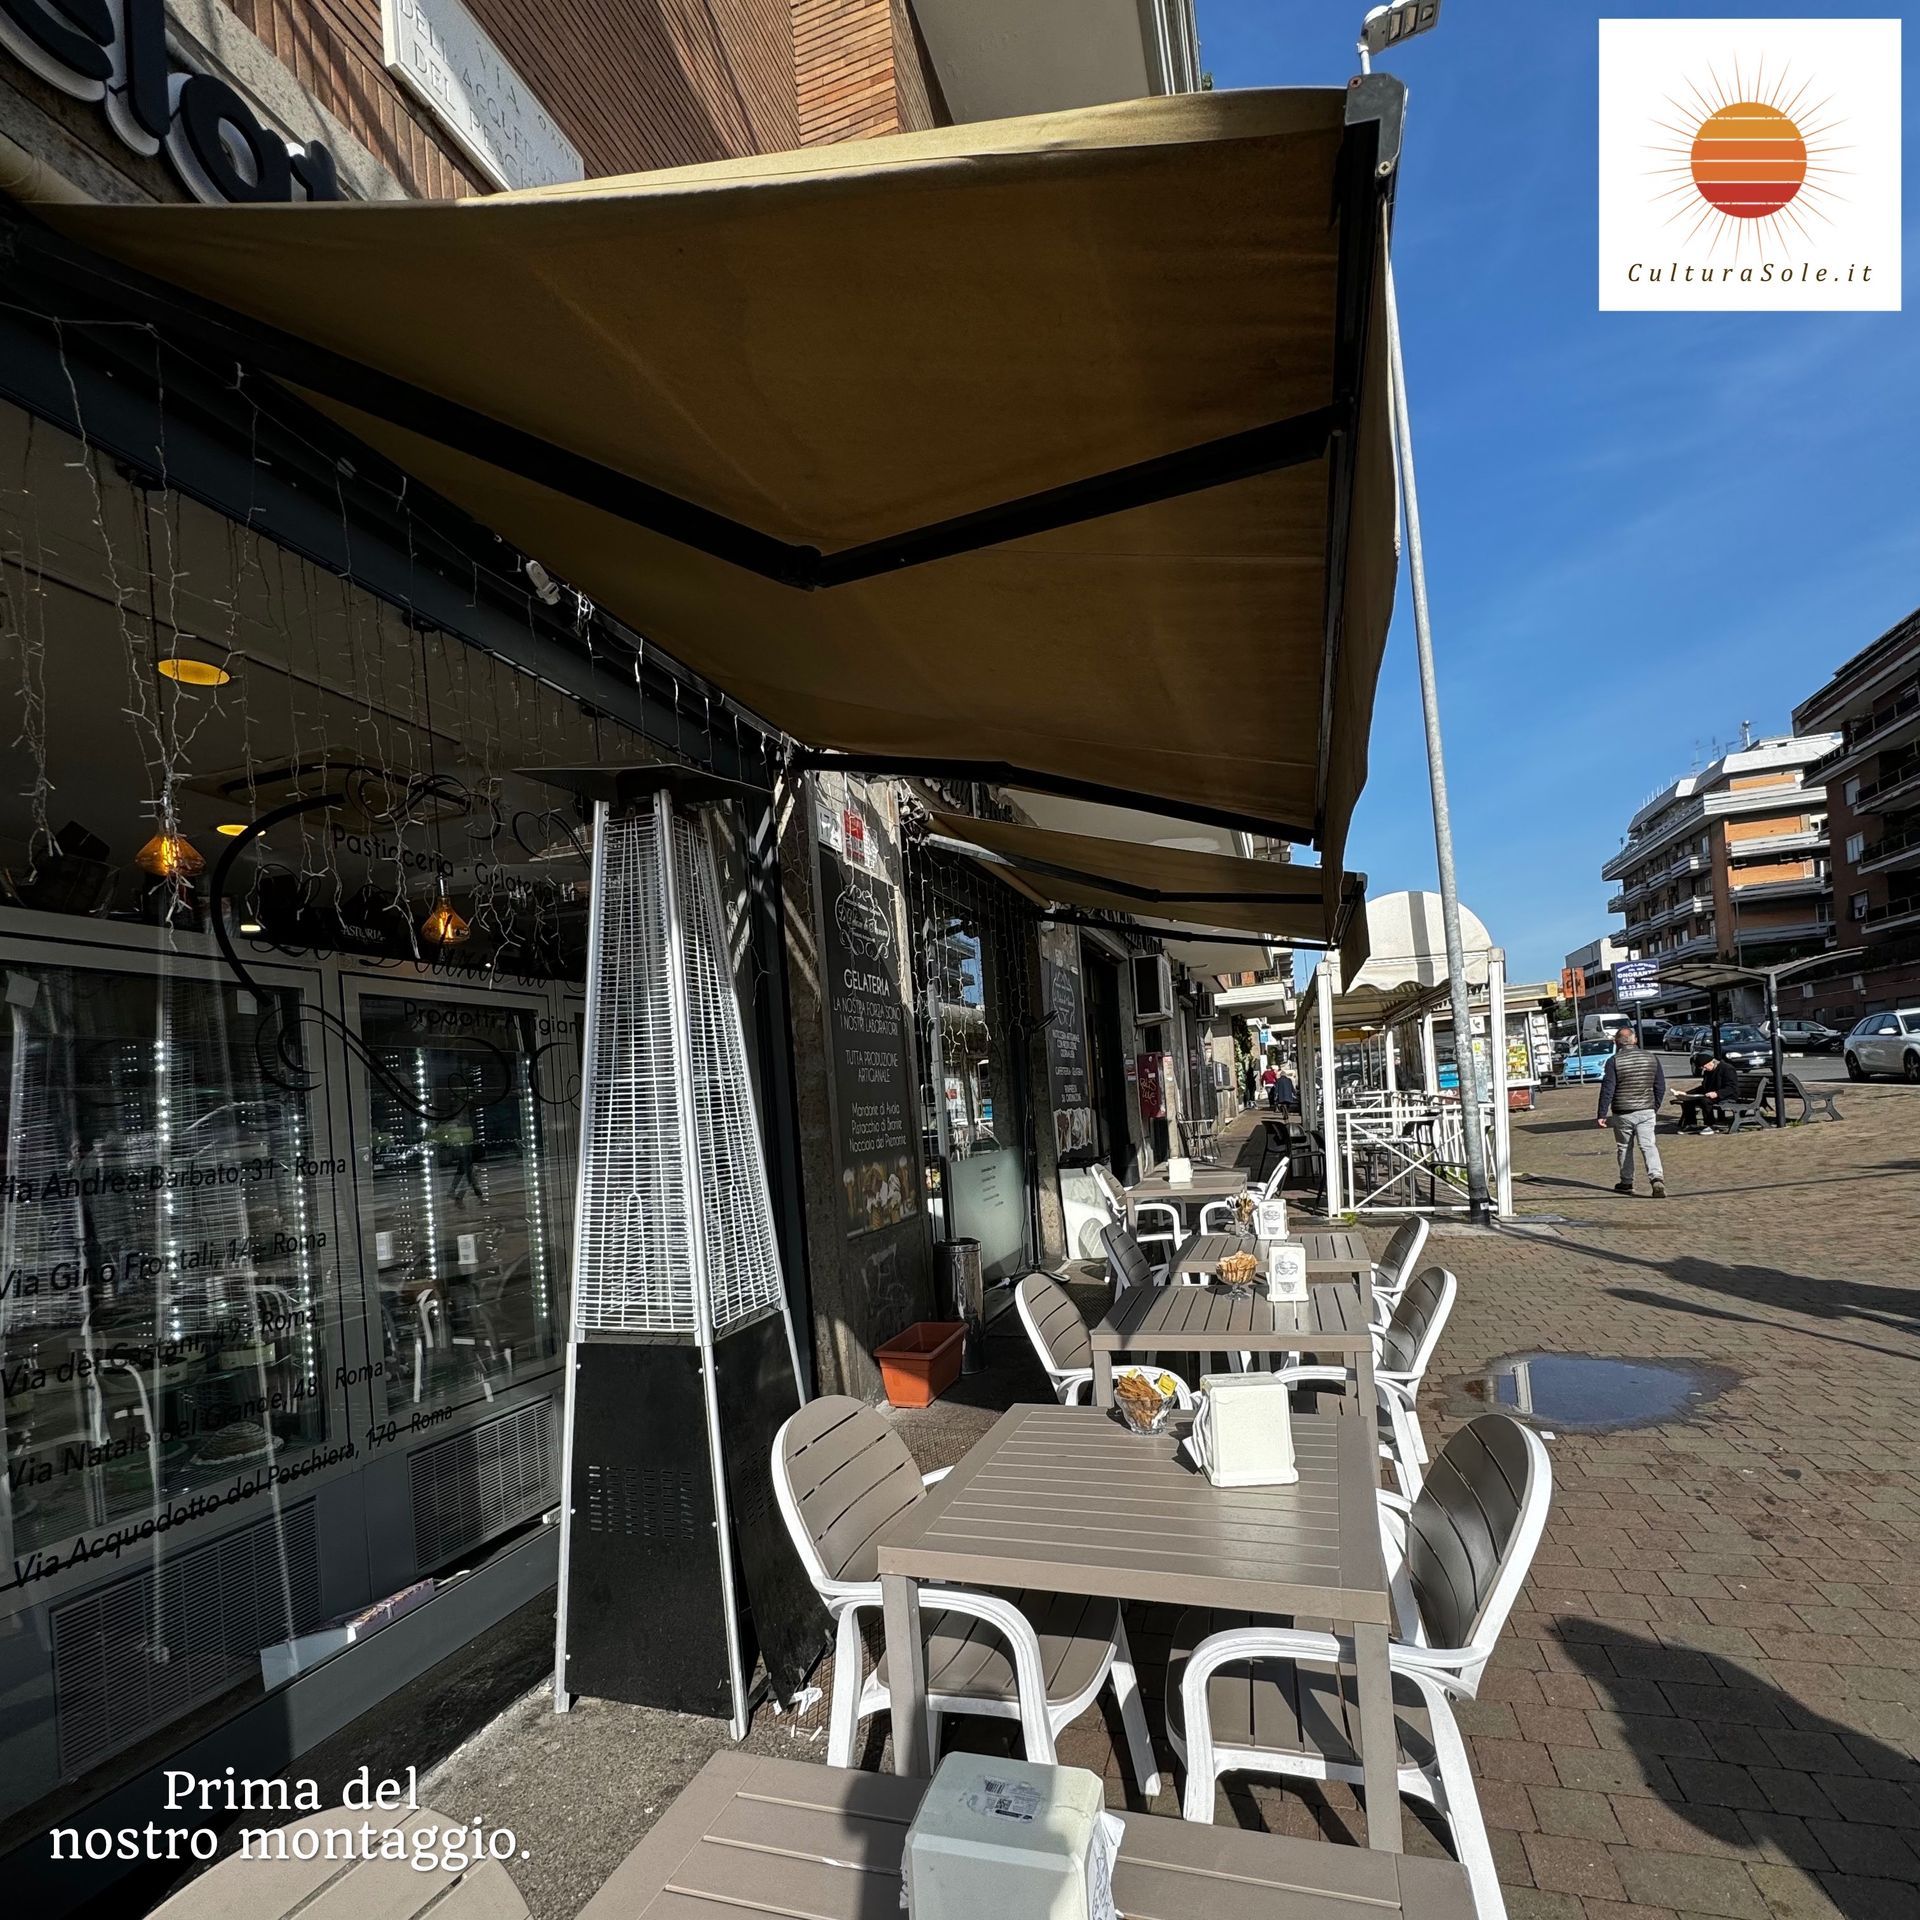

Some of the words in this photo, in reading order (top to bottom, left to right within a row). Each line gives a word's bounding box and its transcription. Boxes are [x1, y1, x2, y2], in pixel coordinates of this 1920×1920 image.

[413, 39, 456, 111] DEL
[475, 39, 520, 115] VIA
[332, 823, 454, 877] Pasticceria
[833, 994, 841, 1011] LA
[841, 997, 866, 1016] NOSTRA
[866, 1001, 884, 1018] FORZA
[885, 1005, 902, 1021] SONO
[843, 968, 891, 998] GELATERIA
[403, 1000, 496, 1030] Prodotti
[843, 1015, 865, 1032] NOSTRI
[845, 1049, 864, 1066] TUTTA
[863, 1051, 899, 1068] PRODUZIONE
[857, 1067, 891, 1084] ARTIGIANALE
[41, 1167, 140, 1201] Andrea
[251, 1157, 275, 1182] 31
[295, 1156, 346, 1177] Roma
[51, 1260, 115, 1290] Gino
[274, 1232, 326, 1254] Roma
[1, 1364, 46, 1398] Via
[213, 1317, 241, 1344] 49
[261, 1305, 316, 1335] Roma
[7, 1457, 52, 1492] Via
[64, 1426, 151, 1475] Natale
[160, 1409, 197, 1443] del
[293, 1375, 318, 1401] 48
[335, 1361, 384, 1390] Roma
[14, 1552, 59, 1587] Via
[66, 1494, 220, 1569] Acquedotto
[227, 1468, 261, 1504] del
[268, 1442, 360, 1491] Peschiera,
[366, 1421, 397, 1450] 170
[411, 1405, 453, 1433] Roma
